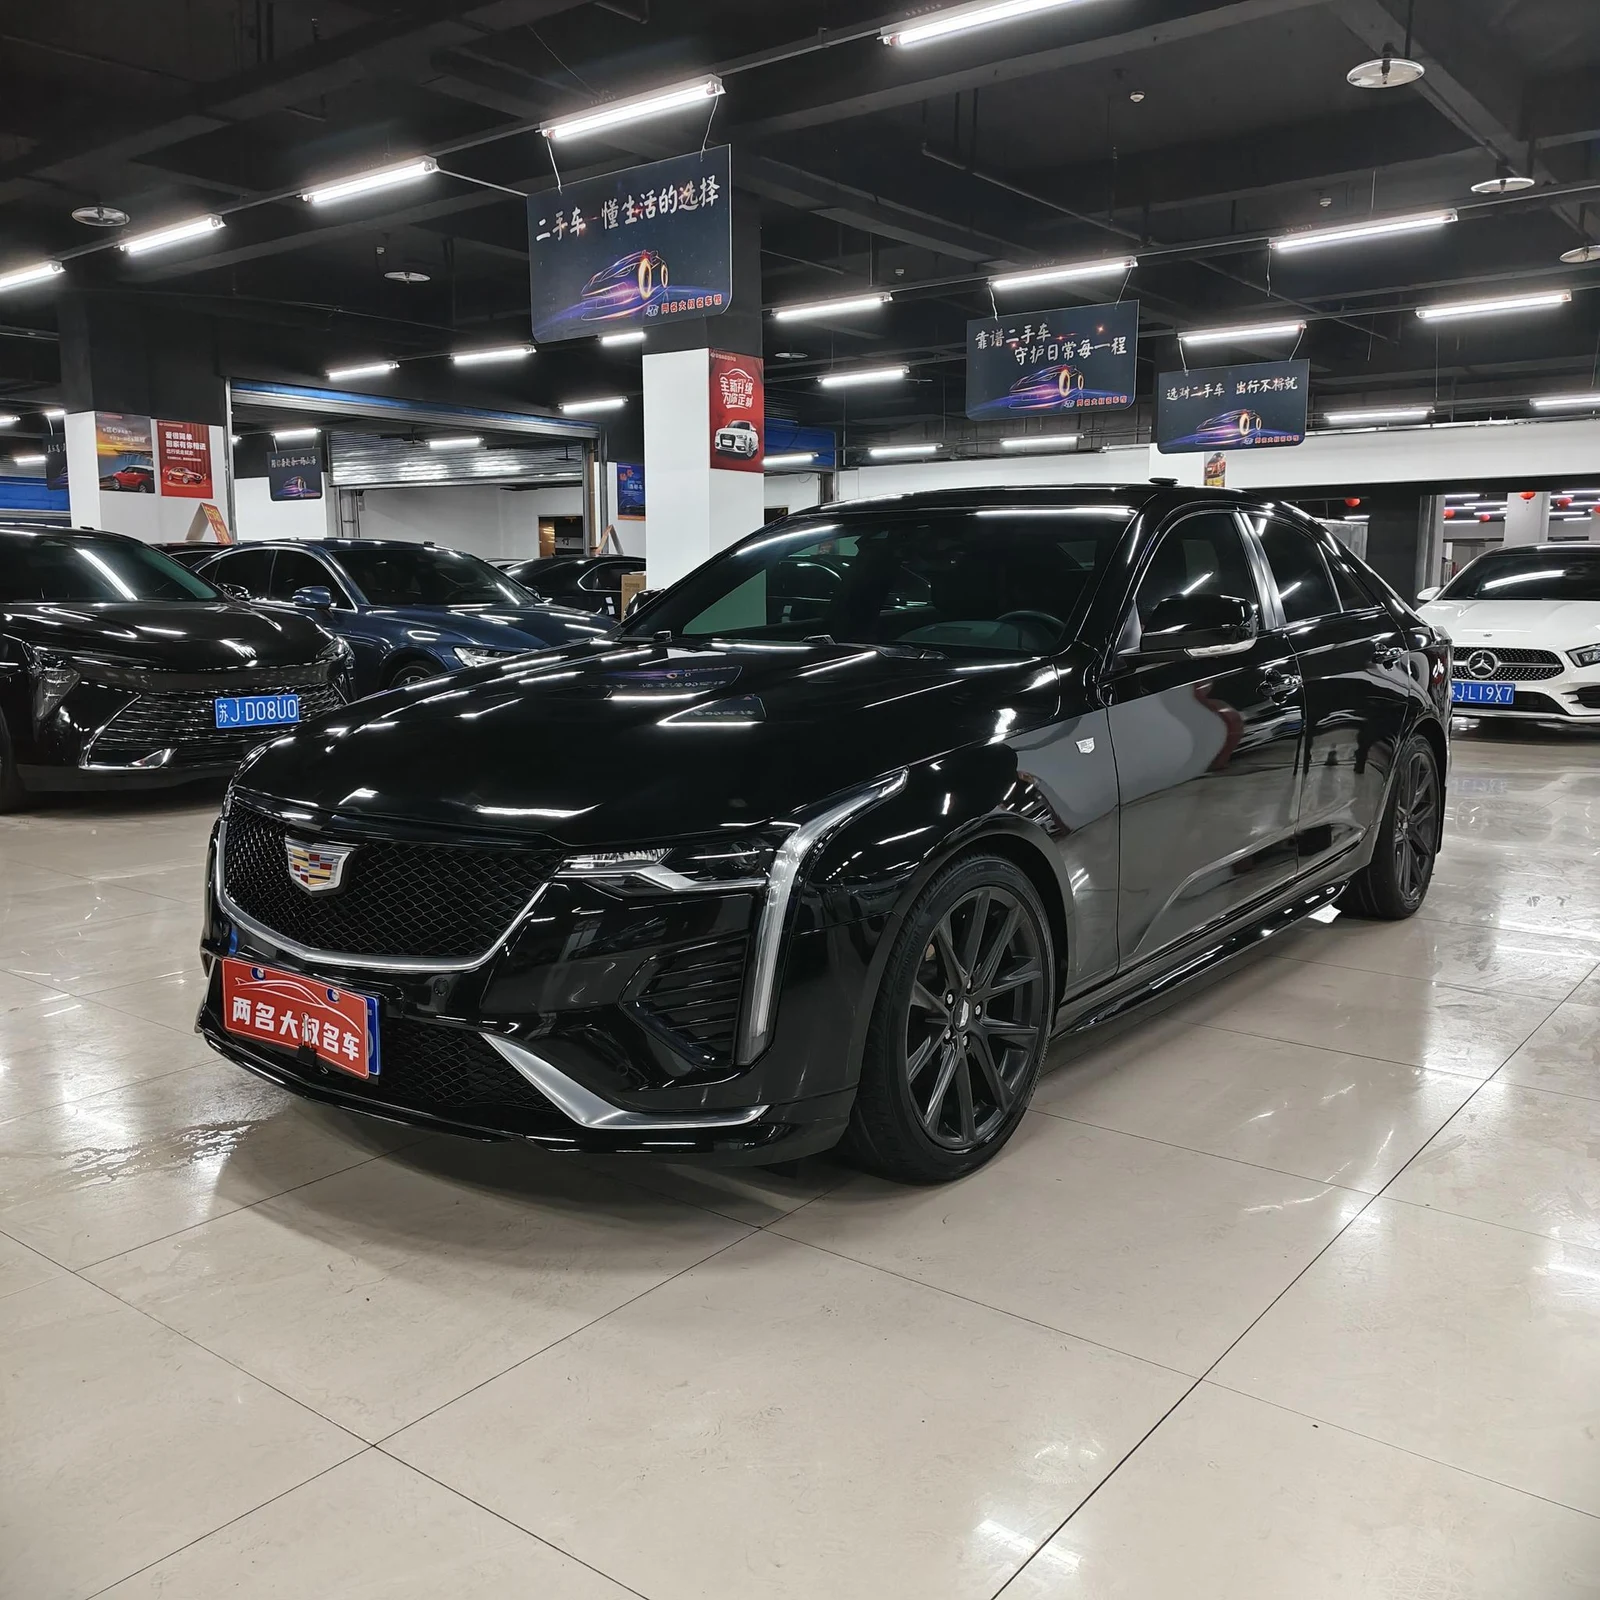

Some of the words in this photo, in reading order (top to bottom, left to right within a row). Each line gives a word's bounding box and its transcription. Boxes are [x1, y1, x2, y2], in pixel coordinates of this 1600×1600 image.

[536, 206, 586, 241] 二手车
[601, 174, 721, 230] 懂生活的选择
[975, 322, 1051, 350] 靠谱二手车
[1014, 336, 1127, 366] 守护日常每一程
[719, 376, 754, 395] 全新升级
[721, 391, 754, 408] 为你定制
[1166, 382, 1226, 401] 选对二手车
[1235, 376, 1298, 395] 出行不将就
[232, 996, 360, 1061] 两名大叔名车
